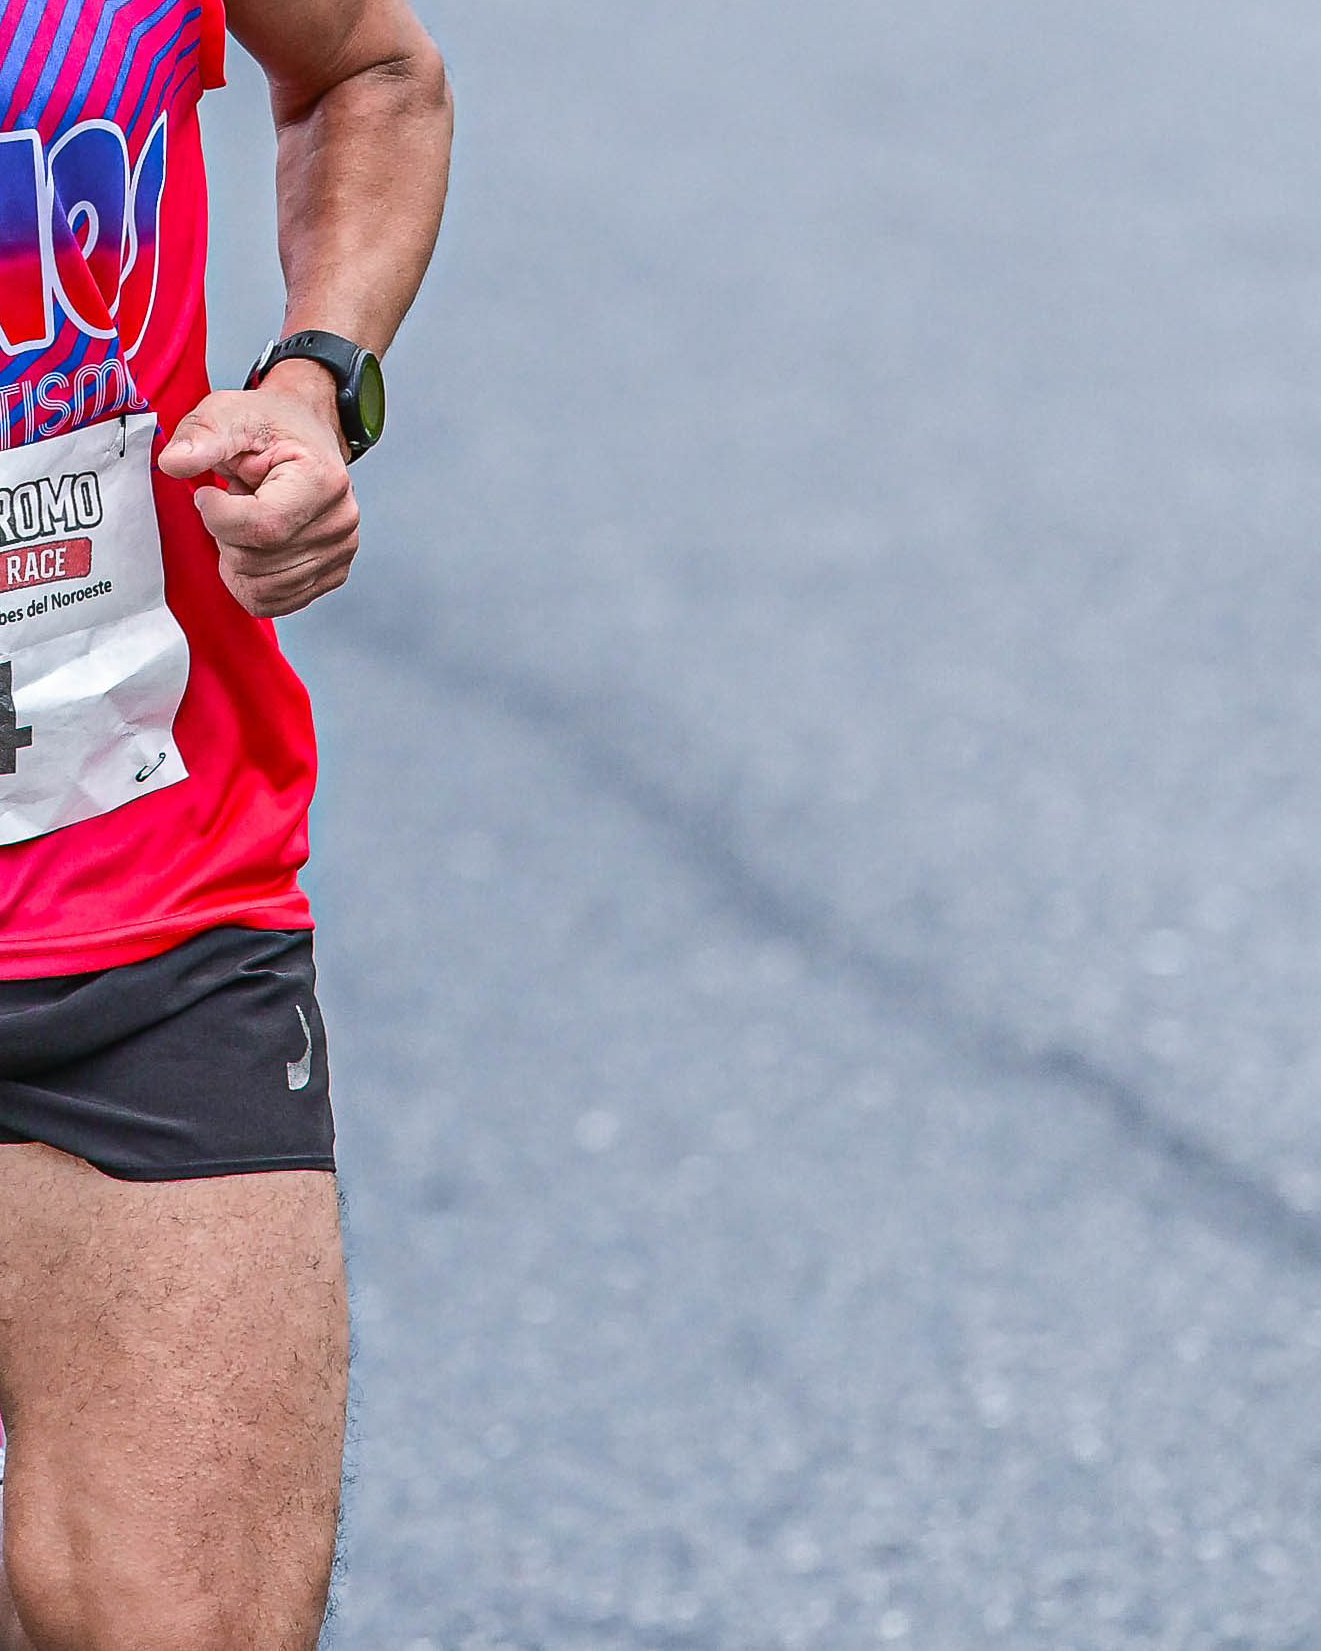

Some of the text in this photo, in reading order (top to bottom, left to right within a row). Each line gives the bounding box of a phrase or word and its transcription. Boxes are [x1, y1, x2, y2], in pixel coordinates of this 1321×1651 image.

[7, 547, 67, 585] RACE
[27, 598, 48, 619] del
[50, 578, 113, 610] Noroeste
